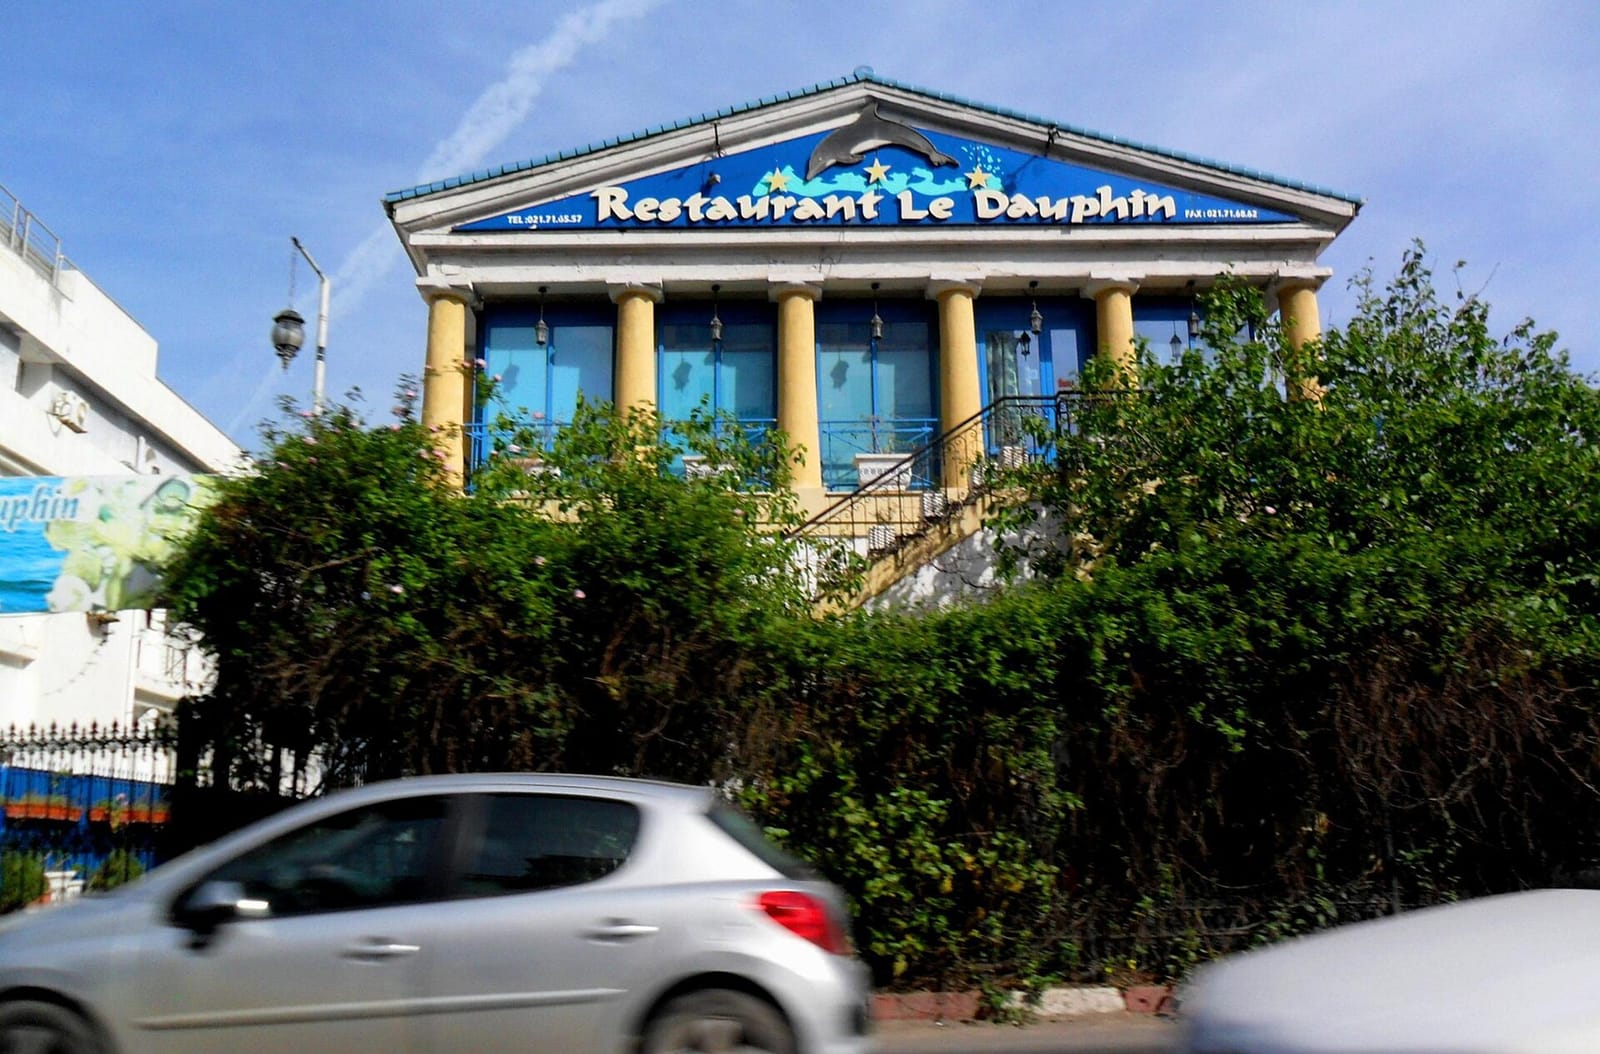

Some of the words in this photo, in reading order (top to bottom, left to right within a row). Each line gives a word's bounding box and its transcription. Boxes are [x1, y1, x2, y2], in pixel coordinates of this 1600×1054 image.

[590, 187, 882, 222] Restaurant
[900, 190, 953, 220] Le
[974, 185, 1176, 223] Dauphin
